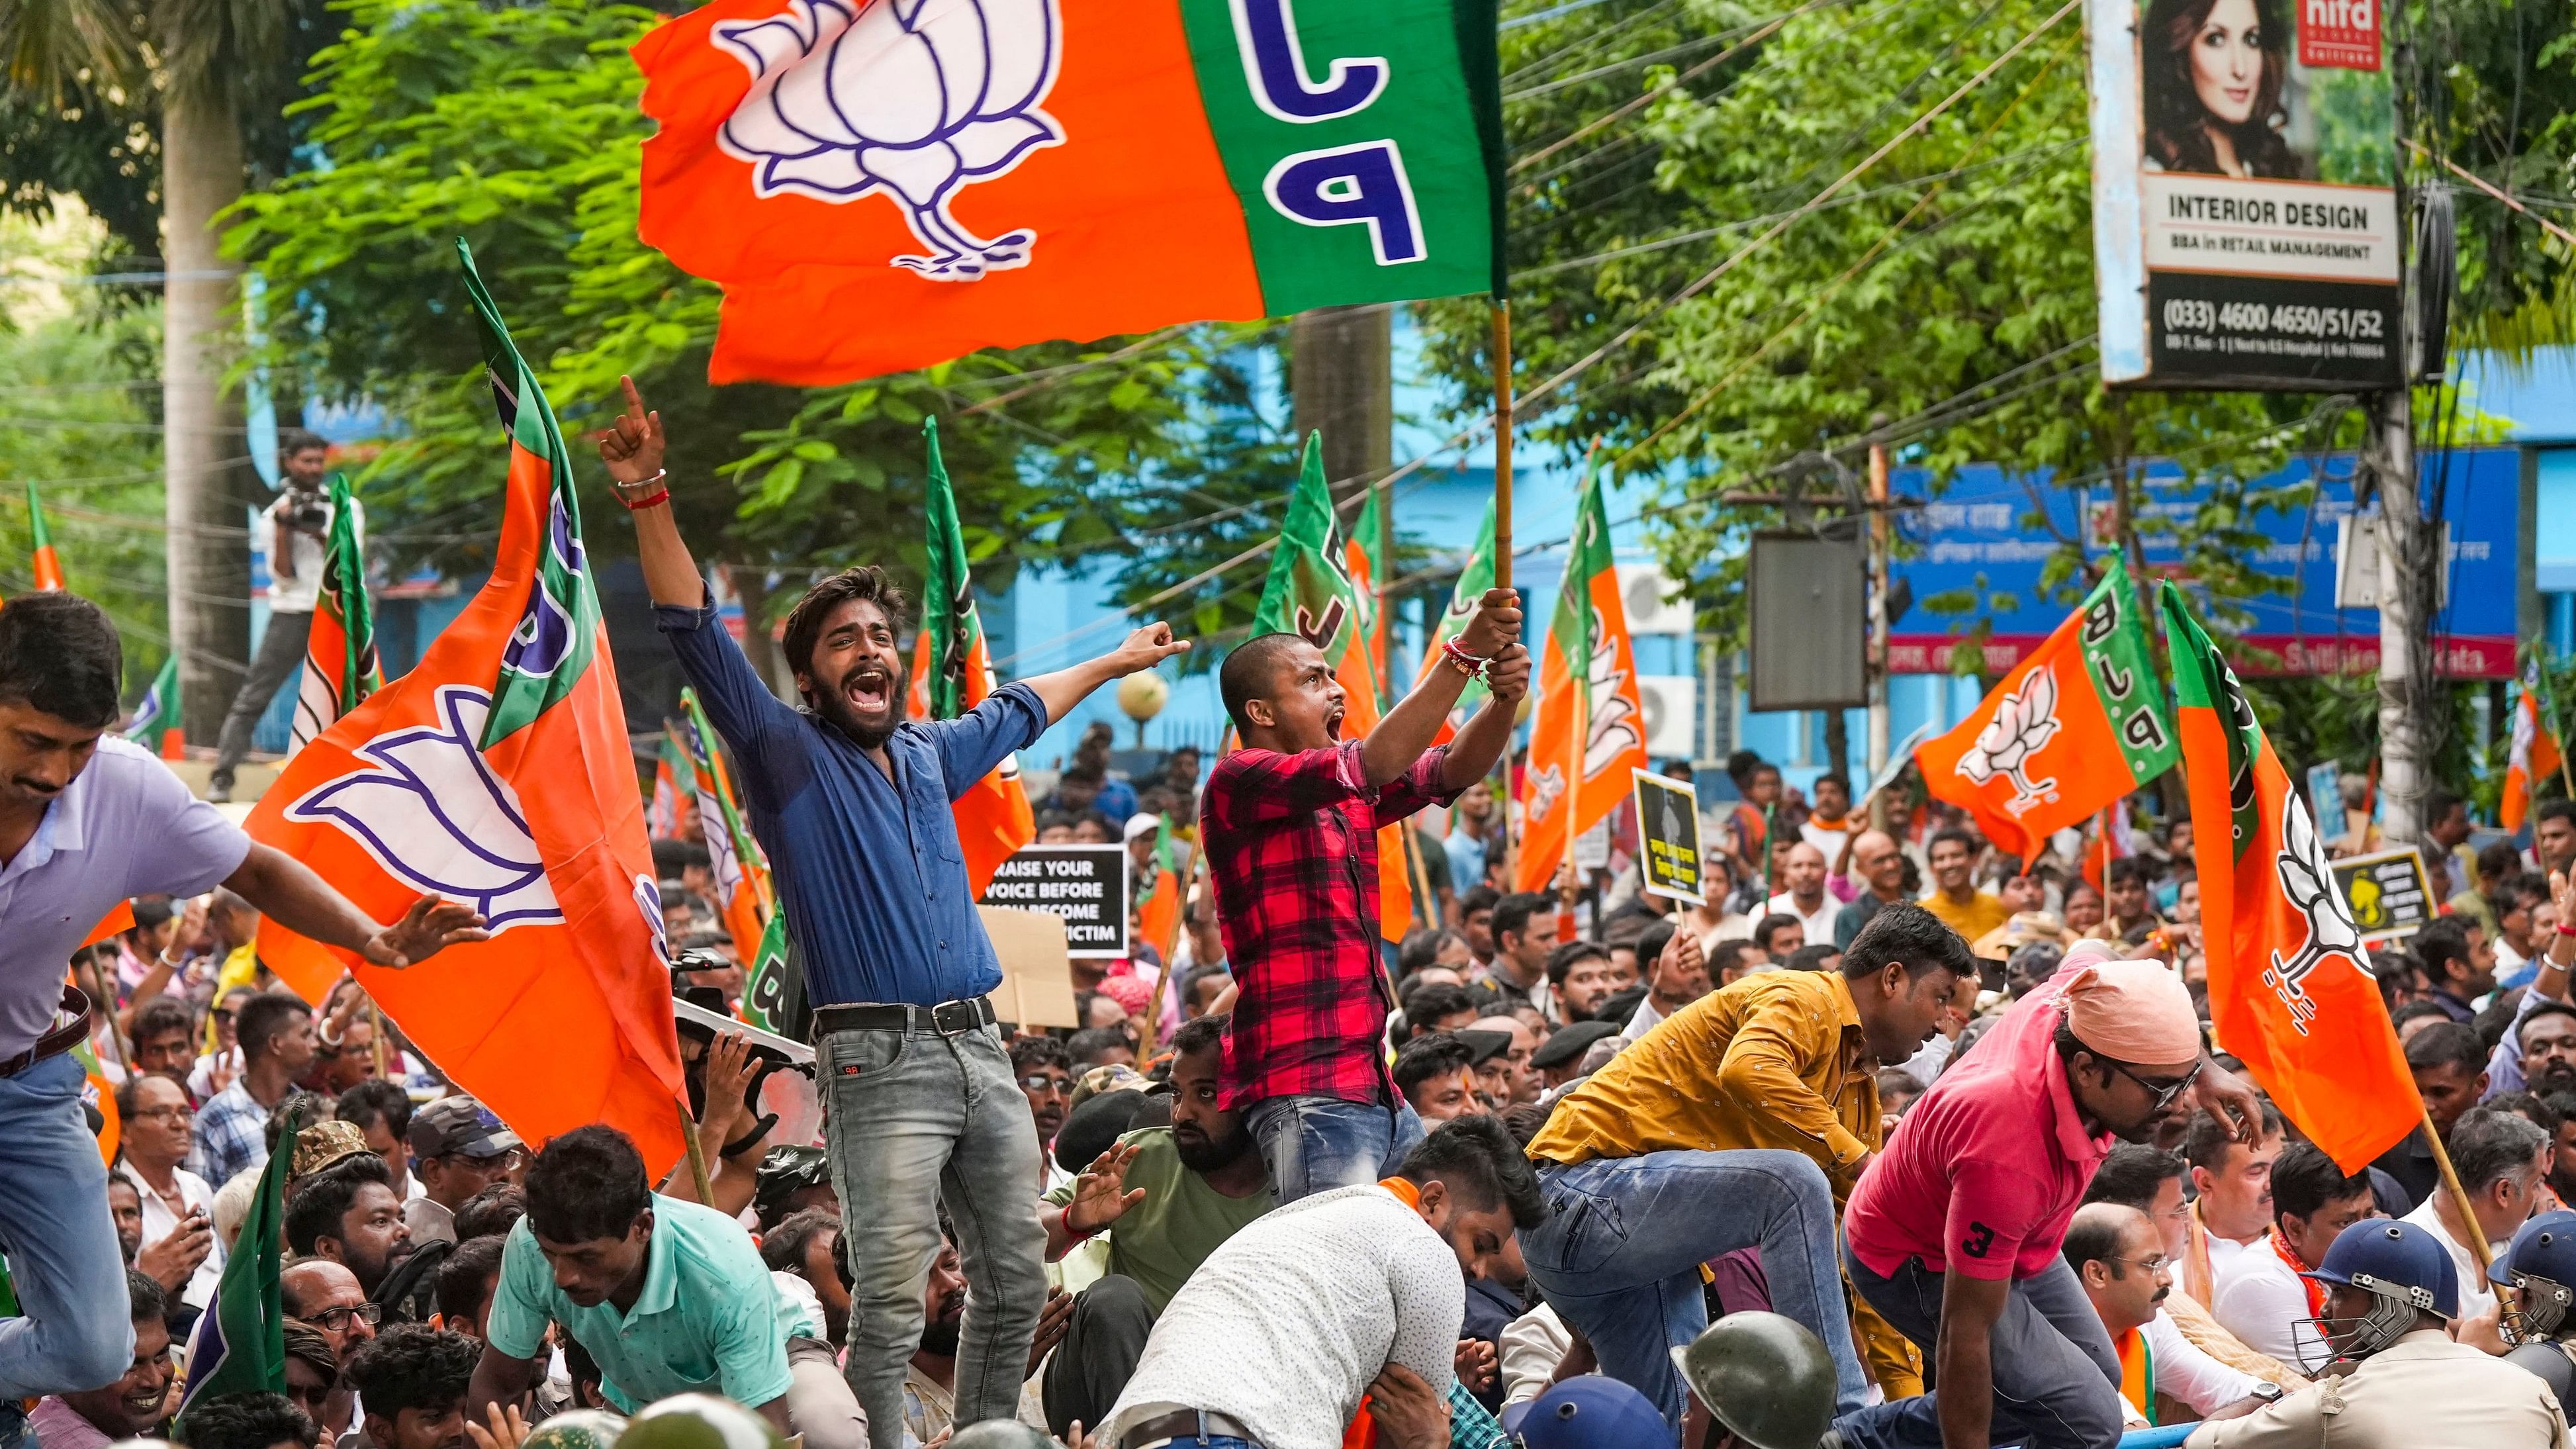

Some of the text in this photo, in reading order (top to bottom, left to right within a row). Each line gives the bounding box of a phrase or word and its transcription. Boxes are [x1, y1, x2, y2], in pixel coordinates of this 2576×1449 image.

[2169, 195, 2367, 229] INTERIOR DESIGN
[2171, 233, 2199, 249] BBA
[2221, 236, 2265, 254] RETAIL
[2270, 240, 2369, 259] MANAGEMENT
[2164, 299, 2383, 340] (033) 4600 4650/51/52
[1045, 861, 1093, 877] YOUR
[986, 882, 1103, 898] VOICE BEFORE
[1064, 925, 1115, 941] ICTIM
[1962, 1221, 1994, 1258] 3
